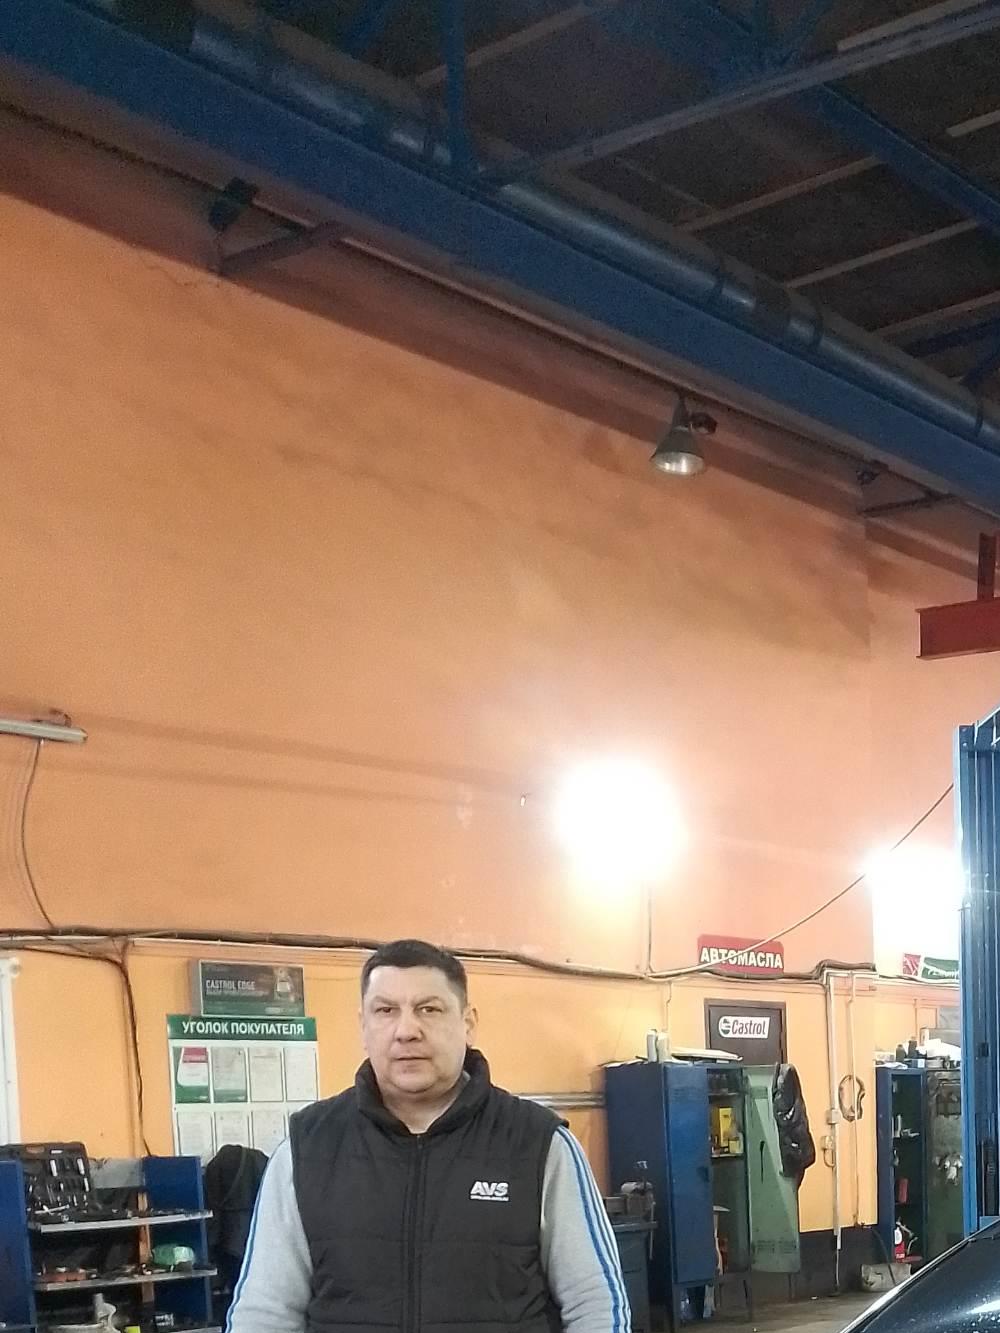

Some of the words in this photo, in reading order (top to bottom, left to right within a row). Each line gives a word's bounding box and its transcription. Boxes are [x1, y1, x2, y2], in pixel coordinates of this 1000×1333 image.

[700, 946, 783, 969] АВТОМАСЛА
[182, 1020, 229, 1035] УГОЛОК
[231, 1022, 305, 1036] ПОКУПАТЕЛЯ
[731, 1019, 766, 1036] Castrol
[470, 1181, 509, 1197] AVS
